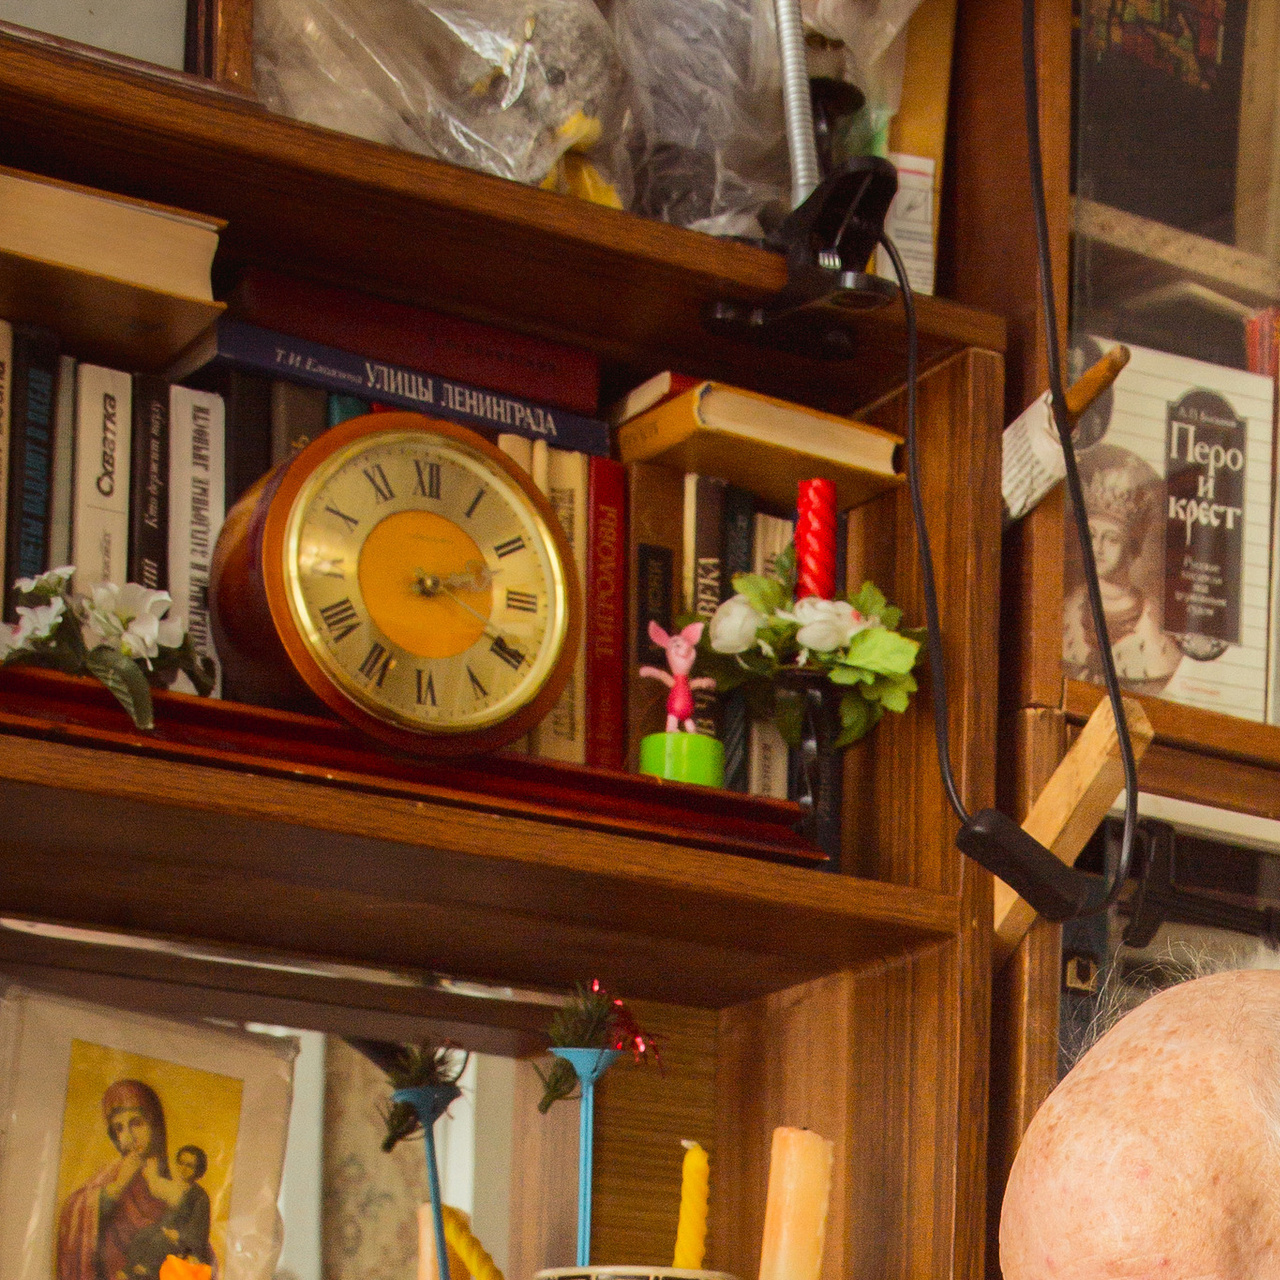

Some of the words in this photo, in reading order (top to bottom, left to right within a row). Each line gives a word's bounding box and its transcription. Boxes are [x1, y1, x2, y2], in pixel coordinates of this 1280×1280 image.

[365, 362, 434, 404] УЛИЦЫ
[440, 386, 558, 437] ЛЕНИНГРАДА
[96, 393, 117, 498] Схватка
[192, 404, 211, 473] ЛИЧНОСТИ
[1170, 421, 1244, 477] Перо
[362, 463, 396, 502] XI
[413, 459, 441, 500] XII
[1197, 475, 1216, 499] и
[324, 504, 359, 533] X
[465, 488, 487, 518] I
[1168, 496, 1242, 545] крест
[493, 535, 526, 559] II
[319, 596, 361, 643] VIII
[506, 589, 538, 613] III
[358, 642, 394, 688] VII
[465, 665, 488, 699] V
[415, 668, 437, 707] VI
